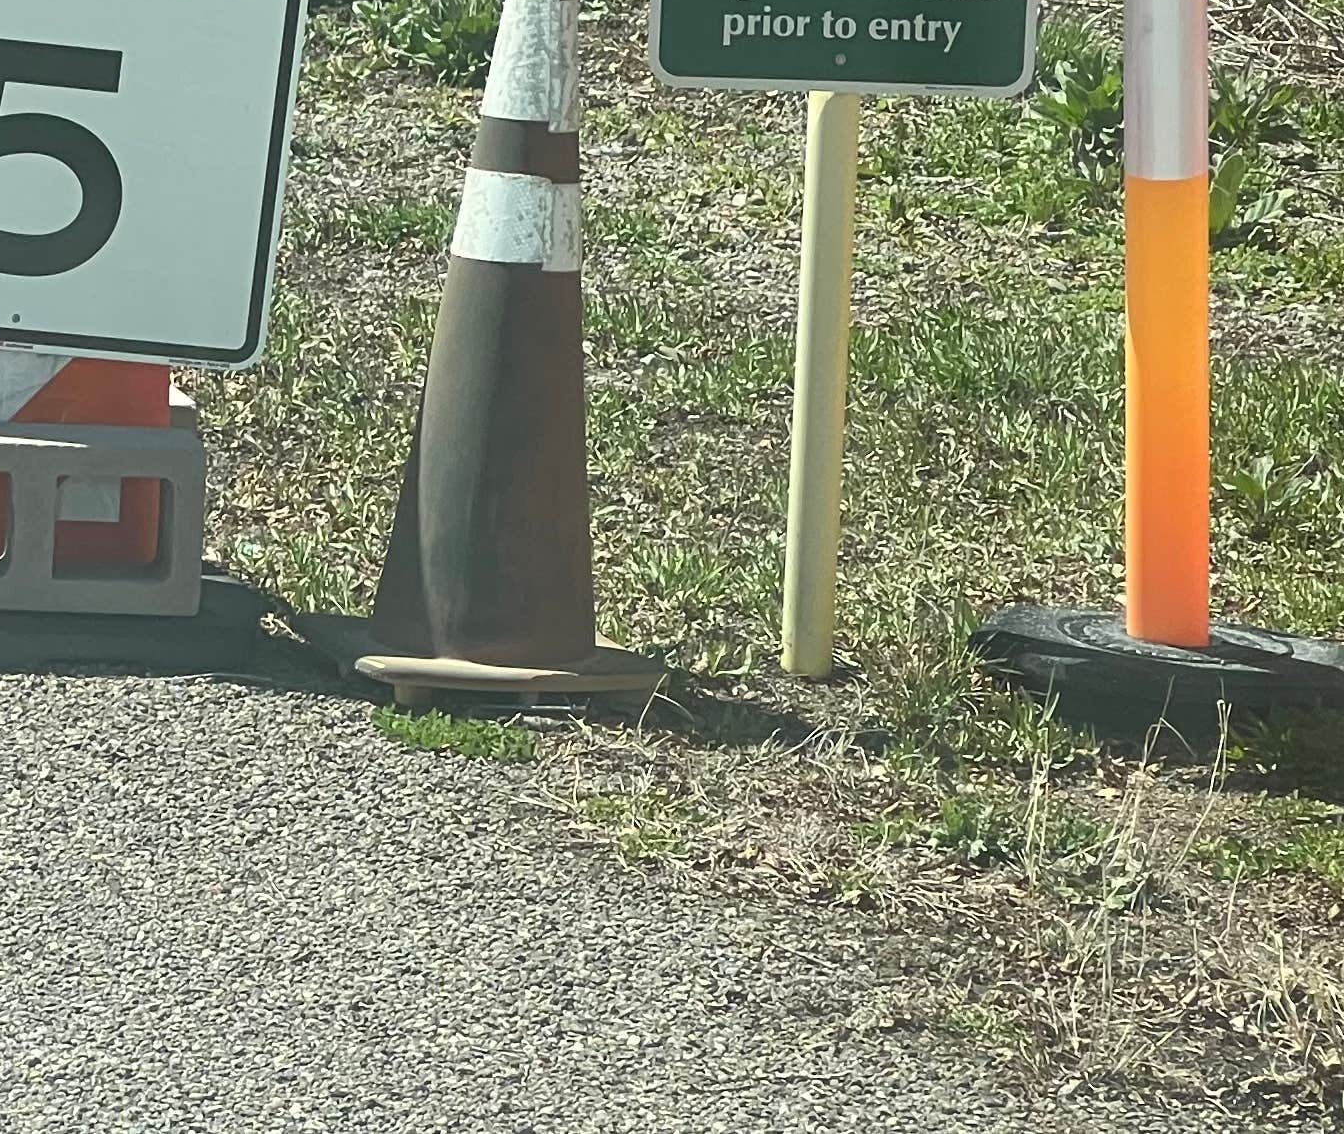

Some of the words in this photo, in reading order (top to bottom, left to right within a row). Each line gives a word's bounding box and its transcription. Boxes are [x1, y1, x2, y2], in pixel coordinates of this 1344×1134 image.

[722, 5, 811, 46] prior
[821, 10, 857, 39] to
[868, 13, 962, 53] entry
